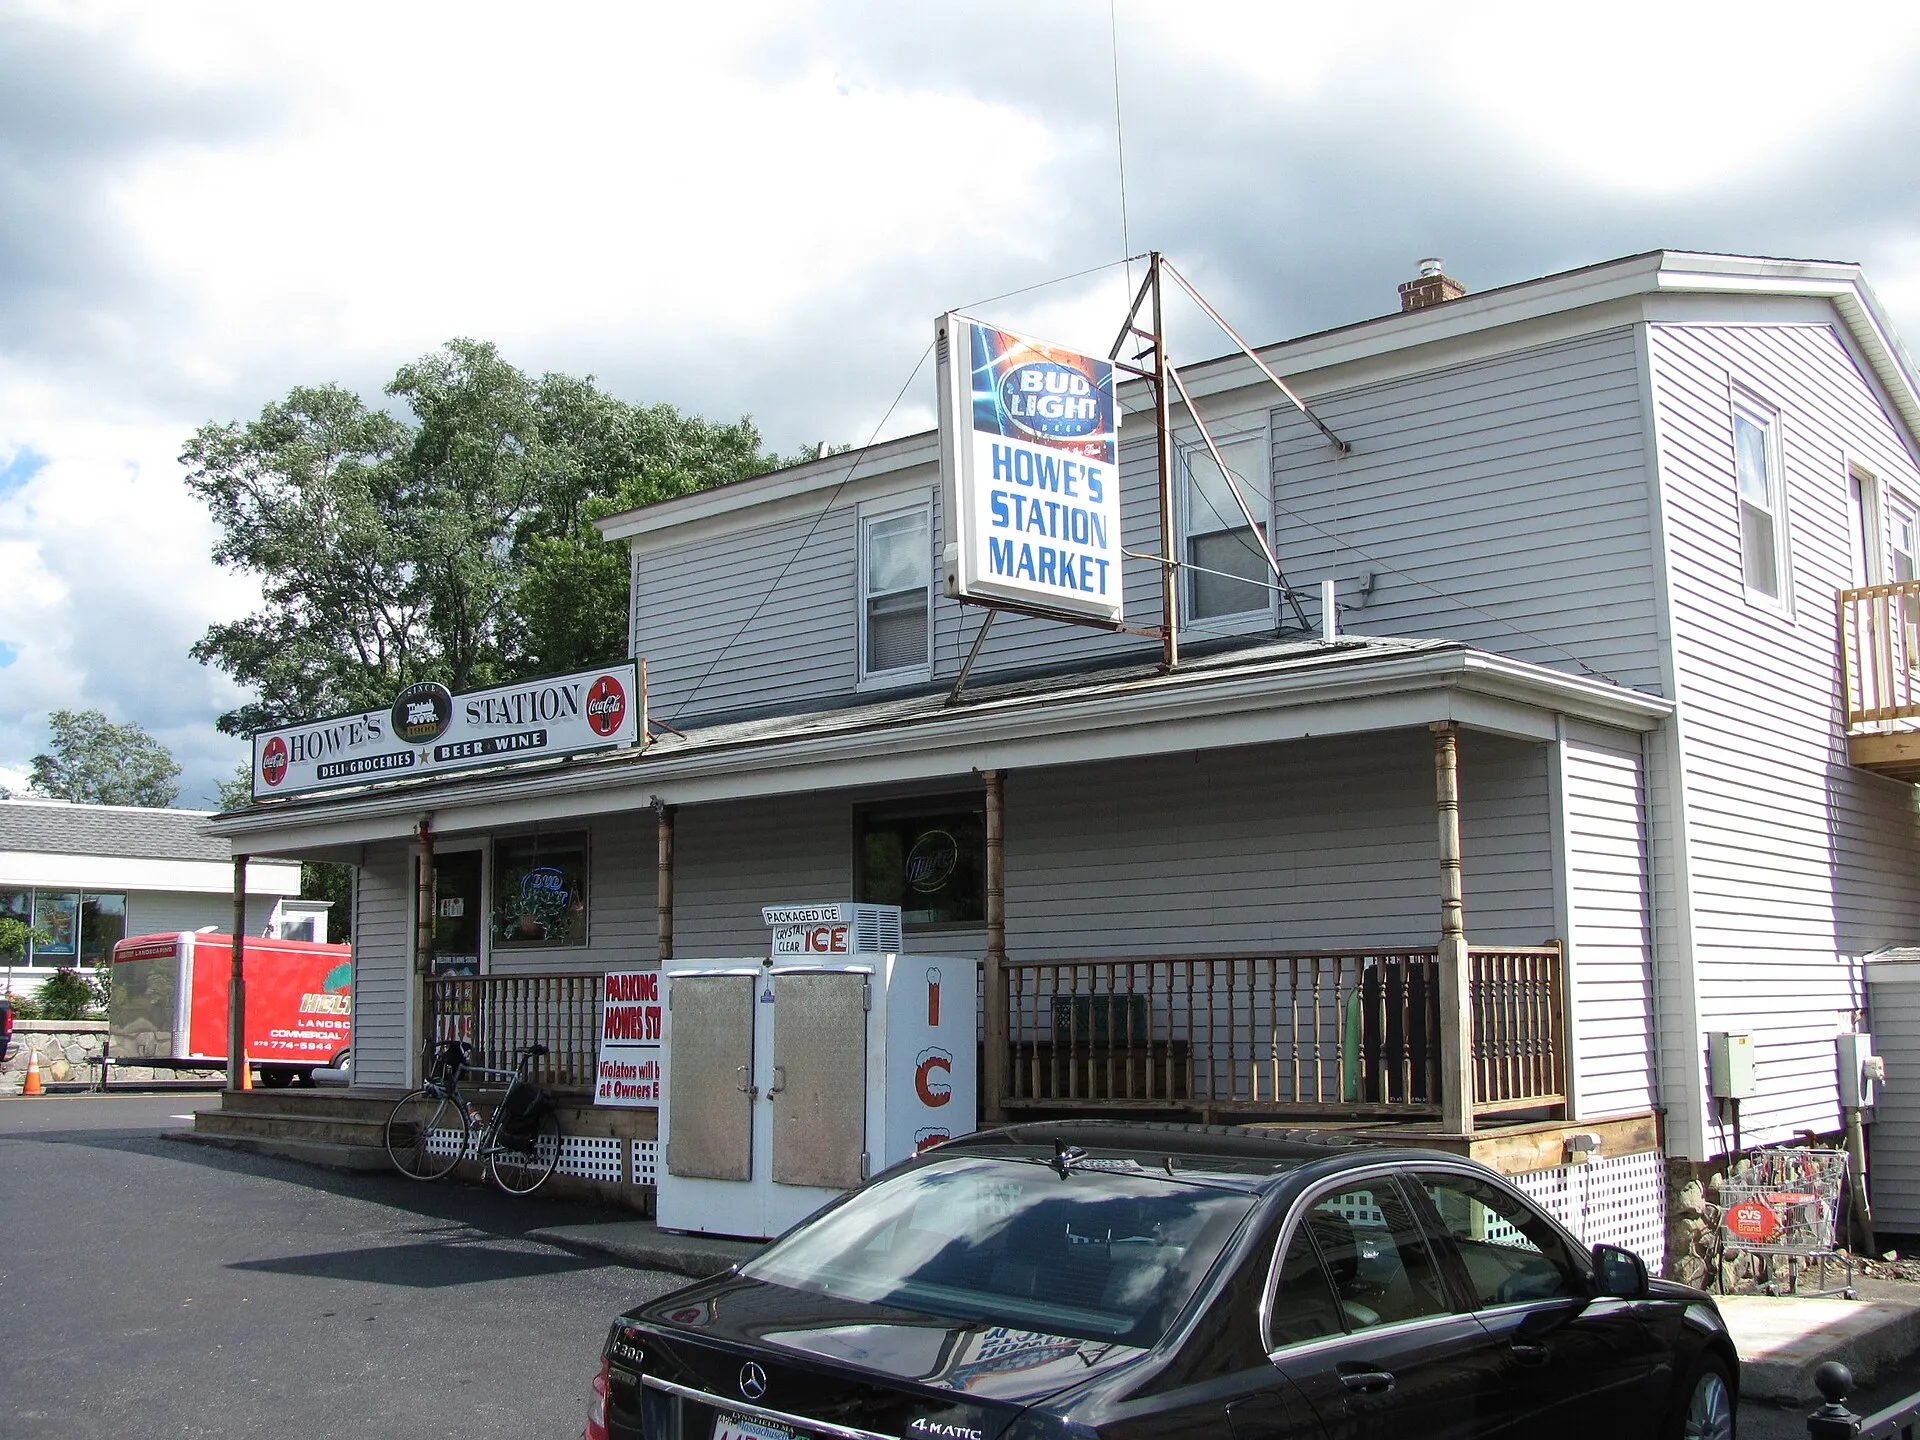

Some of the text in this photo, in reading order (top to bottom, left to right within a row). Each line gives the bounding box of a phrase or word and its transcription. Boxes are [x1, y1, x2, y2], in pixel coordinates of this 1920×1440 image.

[1020, 370, 1090, 396] BUD
[1011, 394, 1096, 419] LIGHT
[1042, 424, 1082, 433] BEER
[992, 443, 1104, 504] HOWE'S
[990, 490, 1107, 550] STATION
[989, 536, 1110, 596] MARKET
[407, 684, 436, 697] SINCE
[288, 684, 581, 763] HOWE'S STATION
[409, 724, 435, 736] 1900
[441, 732, 541, 759] BEER WINE
[322, 753, 411, 777] DELI GROCERIES
[766, 908, 838, 923] PACKAGED ICE
[776, 924, 805, 940] CRYSTAL
[804, 924, 848, 952] ICE
[778, 941, 800, 952] CLEAR
[606, 973, 658, 1002] PARKING
[270, 1029, 342, 1040] COMMERCIAL
[604, 1006, 643, 1040] HOWES
[600, 1060, 637, 1079] Violators
[639, 1060, 653, 1079] will
[599, 1081, 612, 1097] at
[614, 1080, 651, 1099] Owners
[1737, 1210, 1761, 1220] CVS
[1738, 1224, 1761, 1232] Brand
[732, 1411, 794, 1434] LYNNFIELD MA
